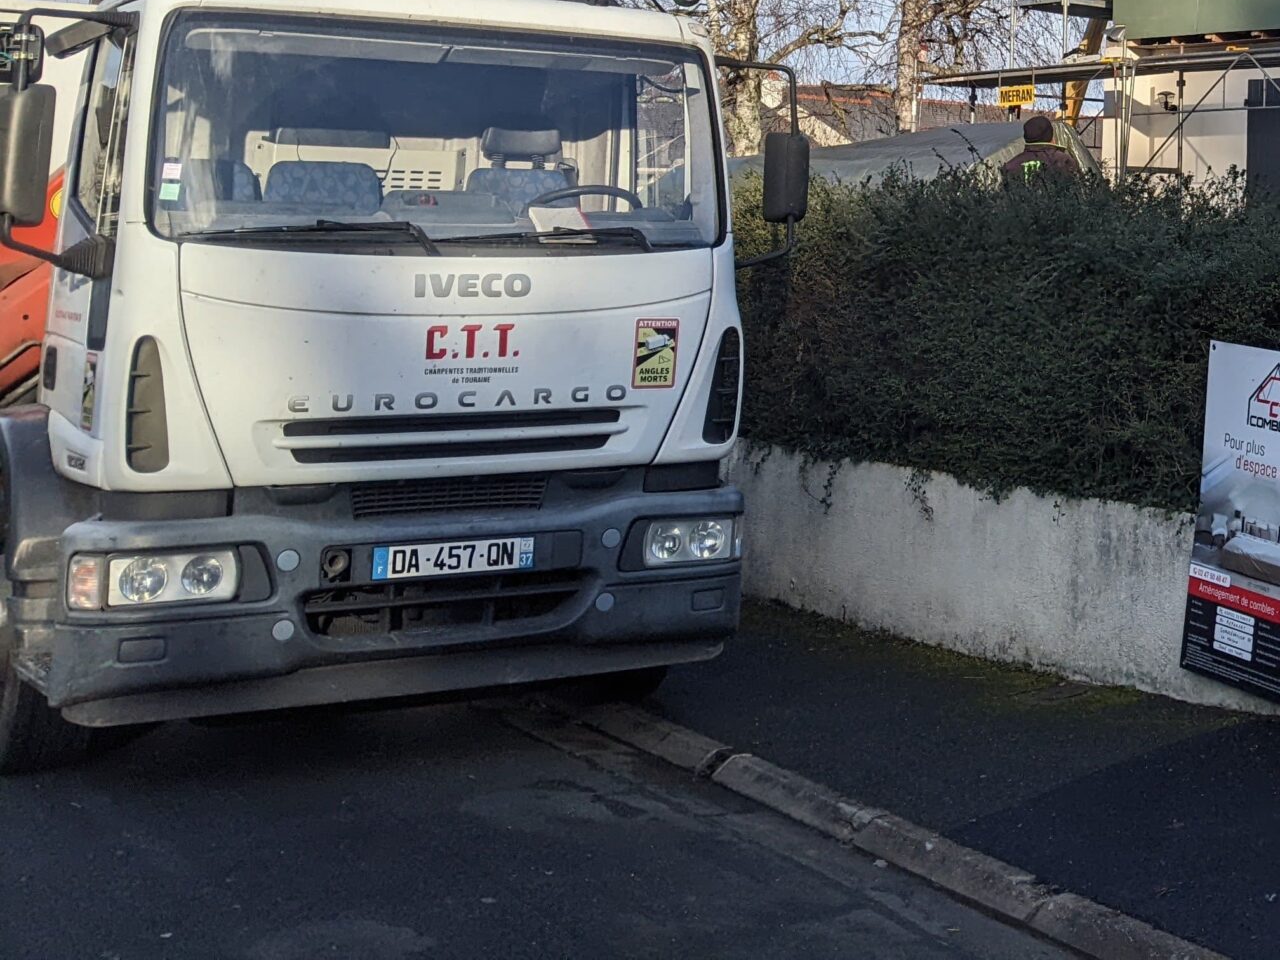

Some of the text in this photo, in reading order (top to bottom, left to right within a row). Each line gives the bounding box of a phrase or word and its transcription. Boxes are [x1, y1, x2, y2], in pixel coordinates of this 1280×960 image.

[1000, 89, 1033, 103] MEFRAN
[414, 273, 532, 298] IVECO
[425, 323, 520, 360] C.T.T.
[424, 366, 519, 376] CHARPENTES TRADITIONNELLES
[451, 376, 491, 384] de TOURAINE
[639, 367, 670, 375] ANGLES
[640, 375, 668, 383] MORTS
[287, 384, 627, 413] EUROCARGO
[1223, 432, 1266, 457] Pour plus
[1235, 454, 1277, 478] d'espace
[377, 566, 384, 574] F
[519, 553, 533, 567] 37
[1198, 582, 1241, 605] Aménagement
[1240, 596, 1249, 607] de
[1249, 599, 1275, 617] combles
